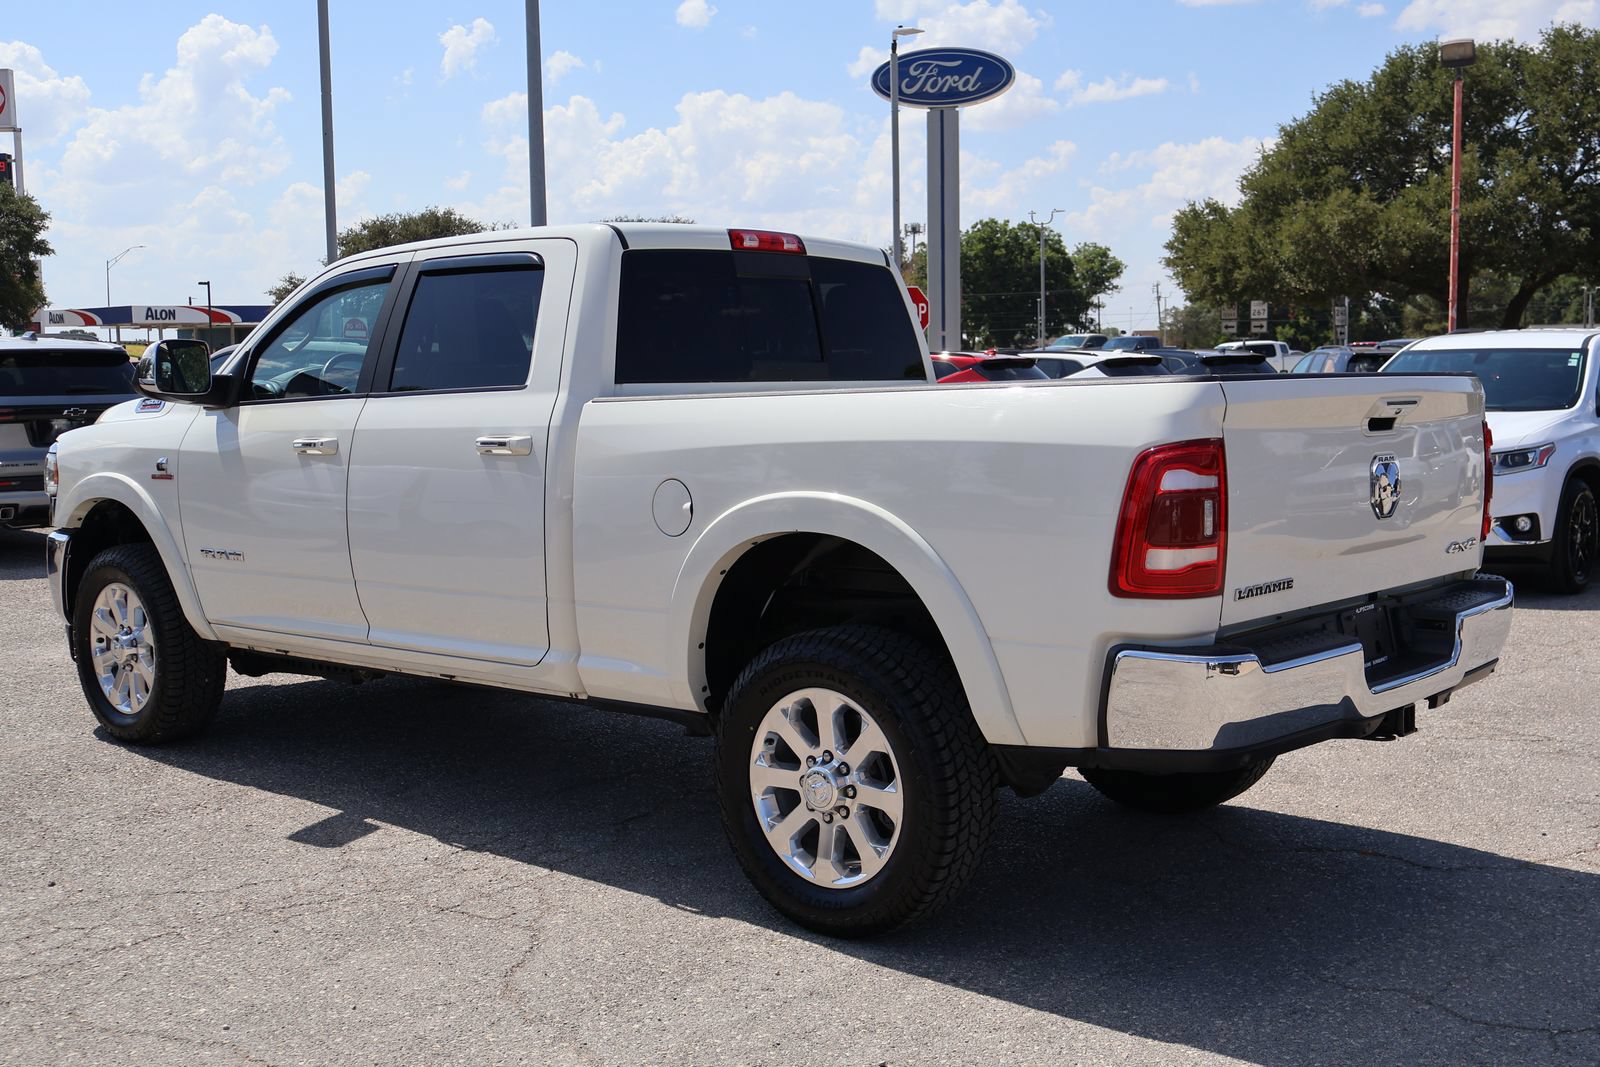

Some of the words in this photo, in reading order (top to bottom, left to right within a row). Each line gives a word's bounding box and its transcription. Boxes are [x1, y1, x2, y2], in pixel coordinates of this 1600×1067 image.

[901, 60, 983, 95] Ford
[49, 311, 65, 324] ALON
[145, 307, 176, 321] ALON
[1252, 309, 1266, 317] 267
[1378, 455, 1395, 463] RAM
[200, 547, 245, 562] RAM
[1234, 577, 1294, 602] LARAMIE
